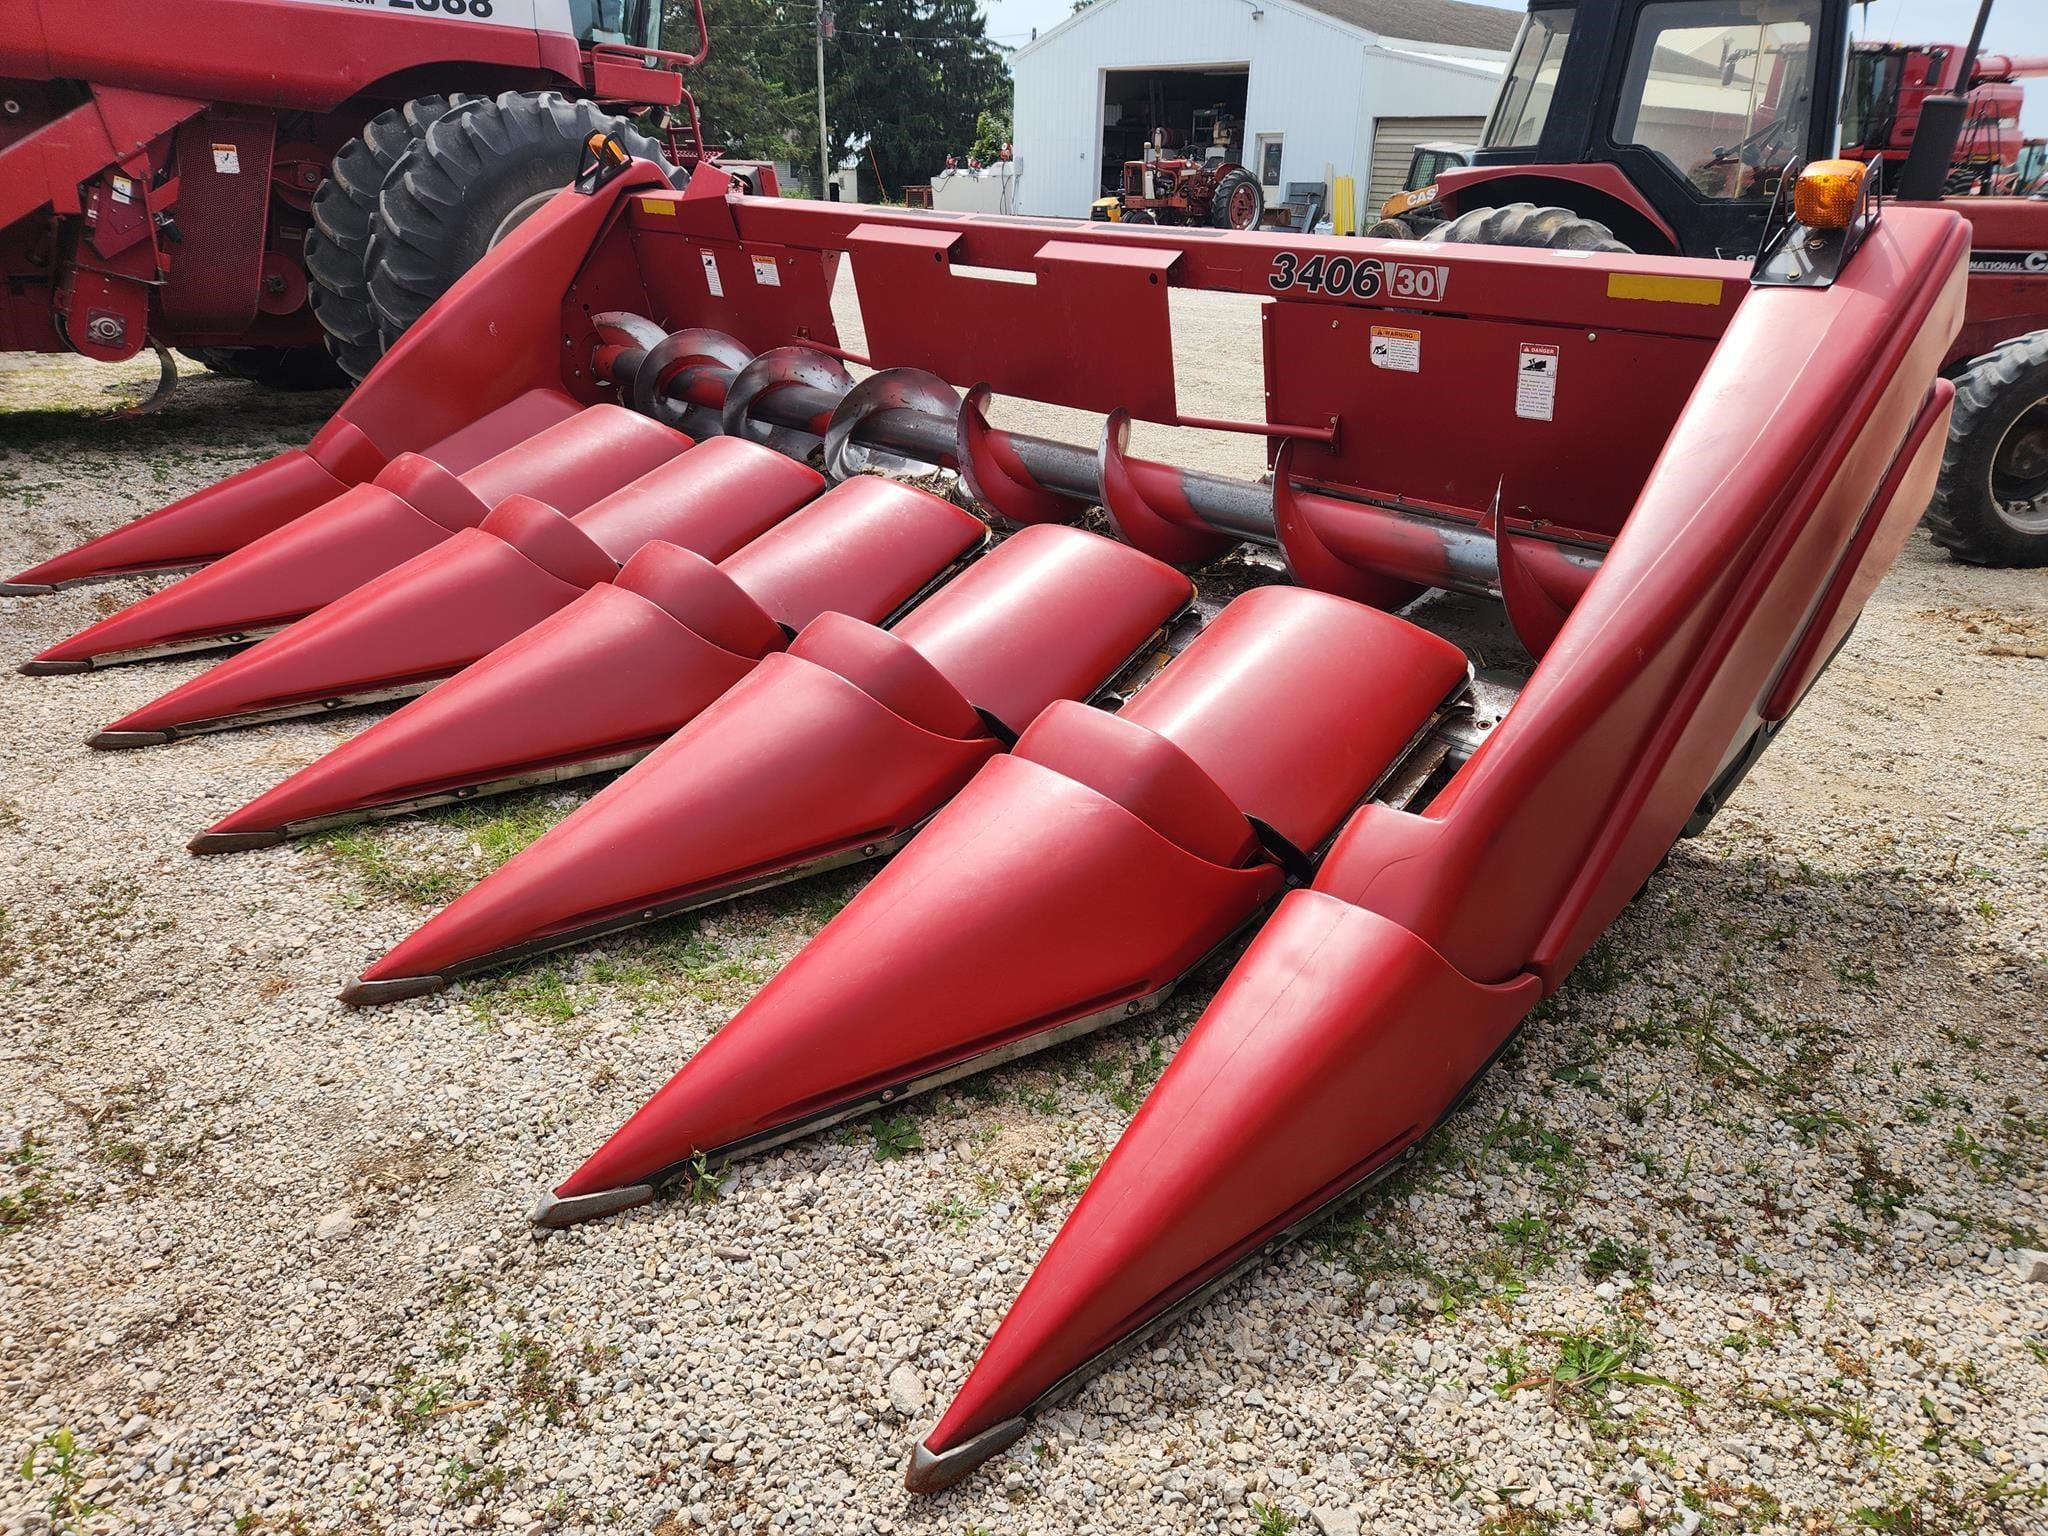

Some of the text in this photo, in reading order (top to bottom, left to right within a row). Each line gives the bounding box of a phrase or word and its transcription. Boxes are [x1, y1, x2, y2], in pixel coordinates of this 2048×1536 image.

[2024, 252, 2048, 271] C
[1268, 251, 1435, 299] 3406 30
[1384, 330, 1413, 339] WARNING
[1531, 347, 1555, 355] DANGER
